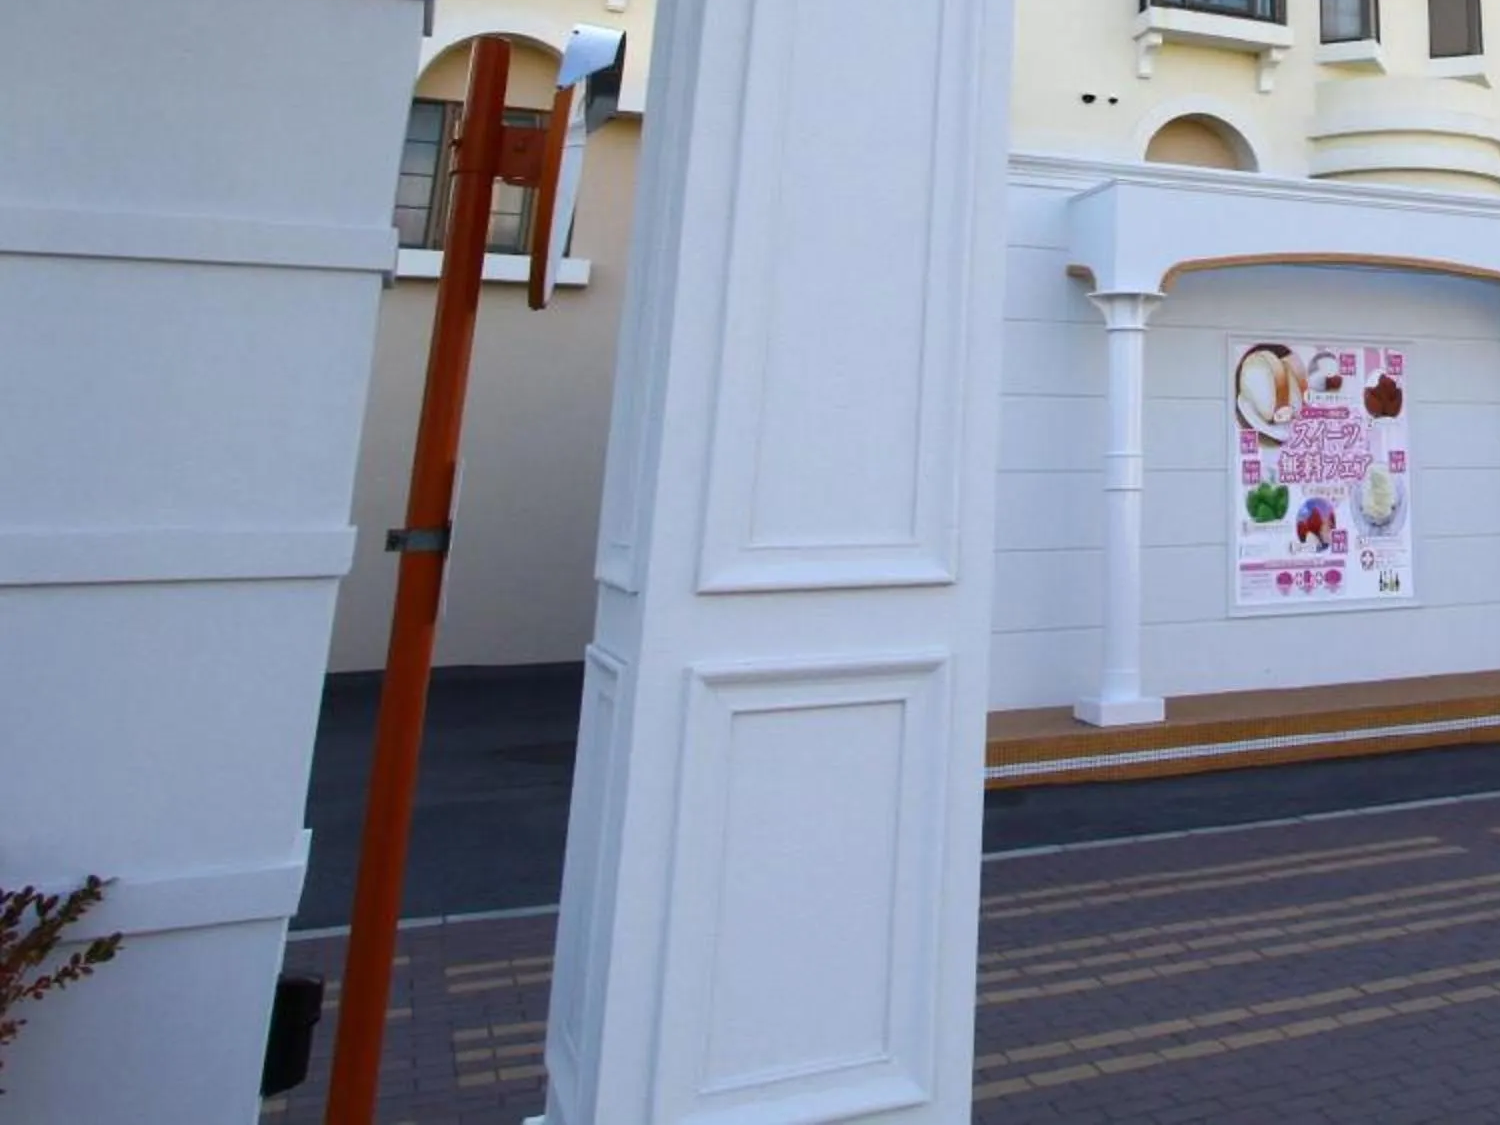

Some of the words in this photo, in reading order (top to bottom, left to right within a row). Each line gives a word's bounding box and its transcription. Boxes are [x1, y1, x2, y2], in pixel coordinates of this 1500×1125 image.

[1292, 422, 1360, 449] スイーツ
[1280, 451, 1372, 482] 無料フェア
